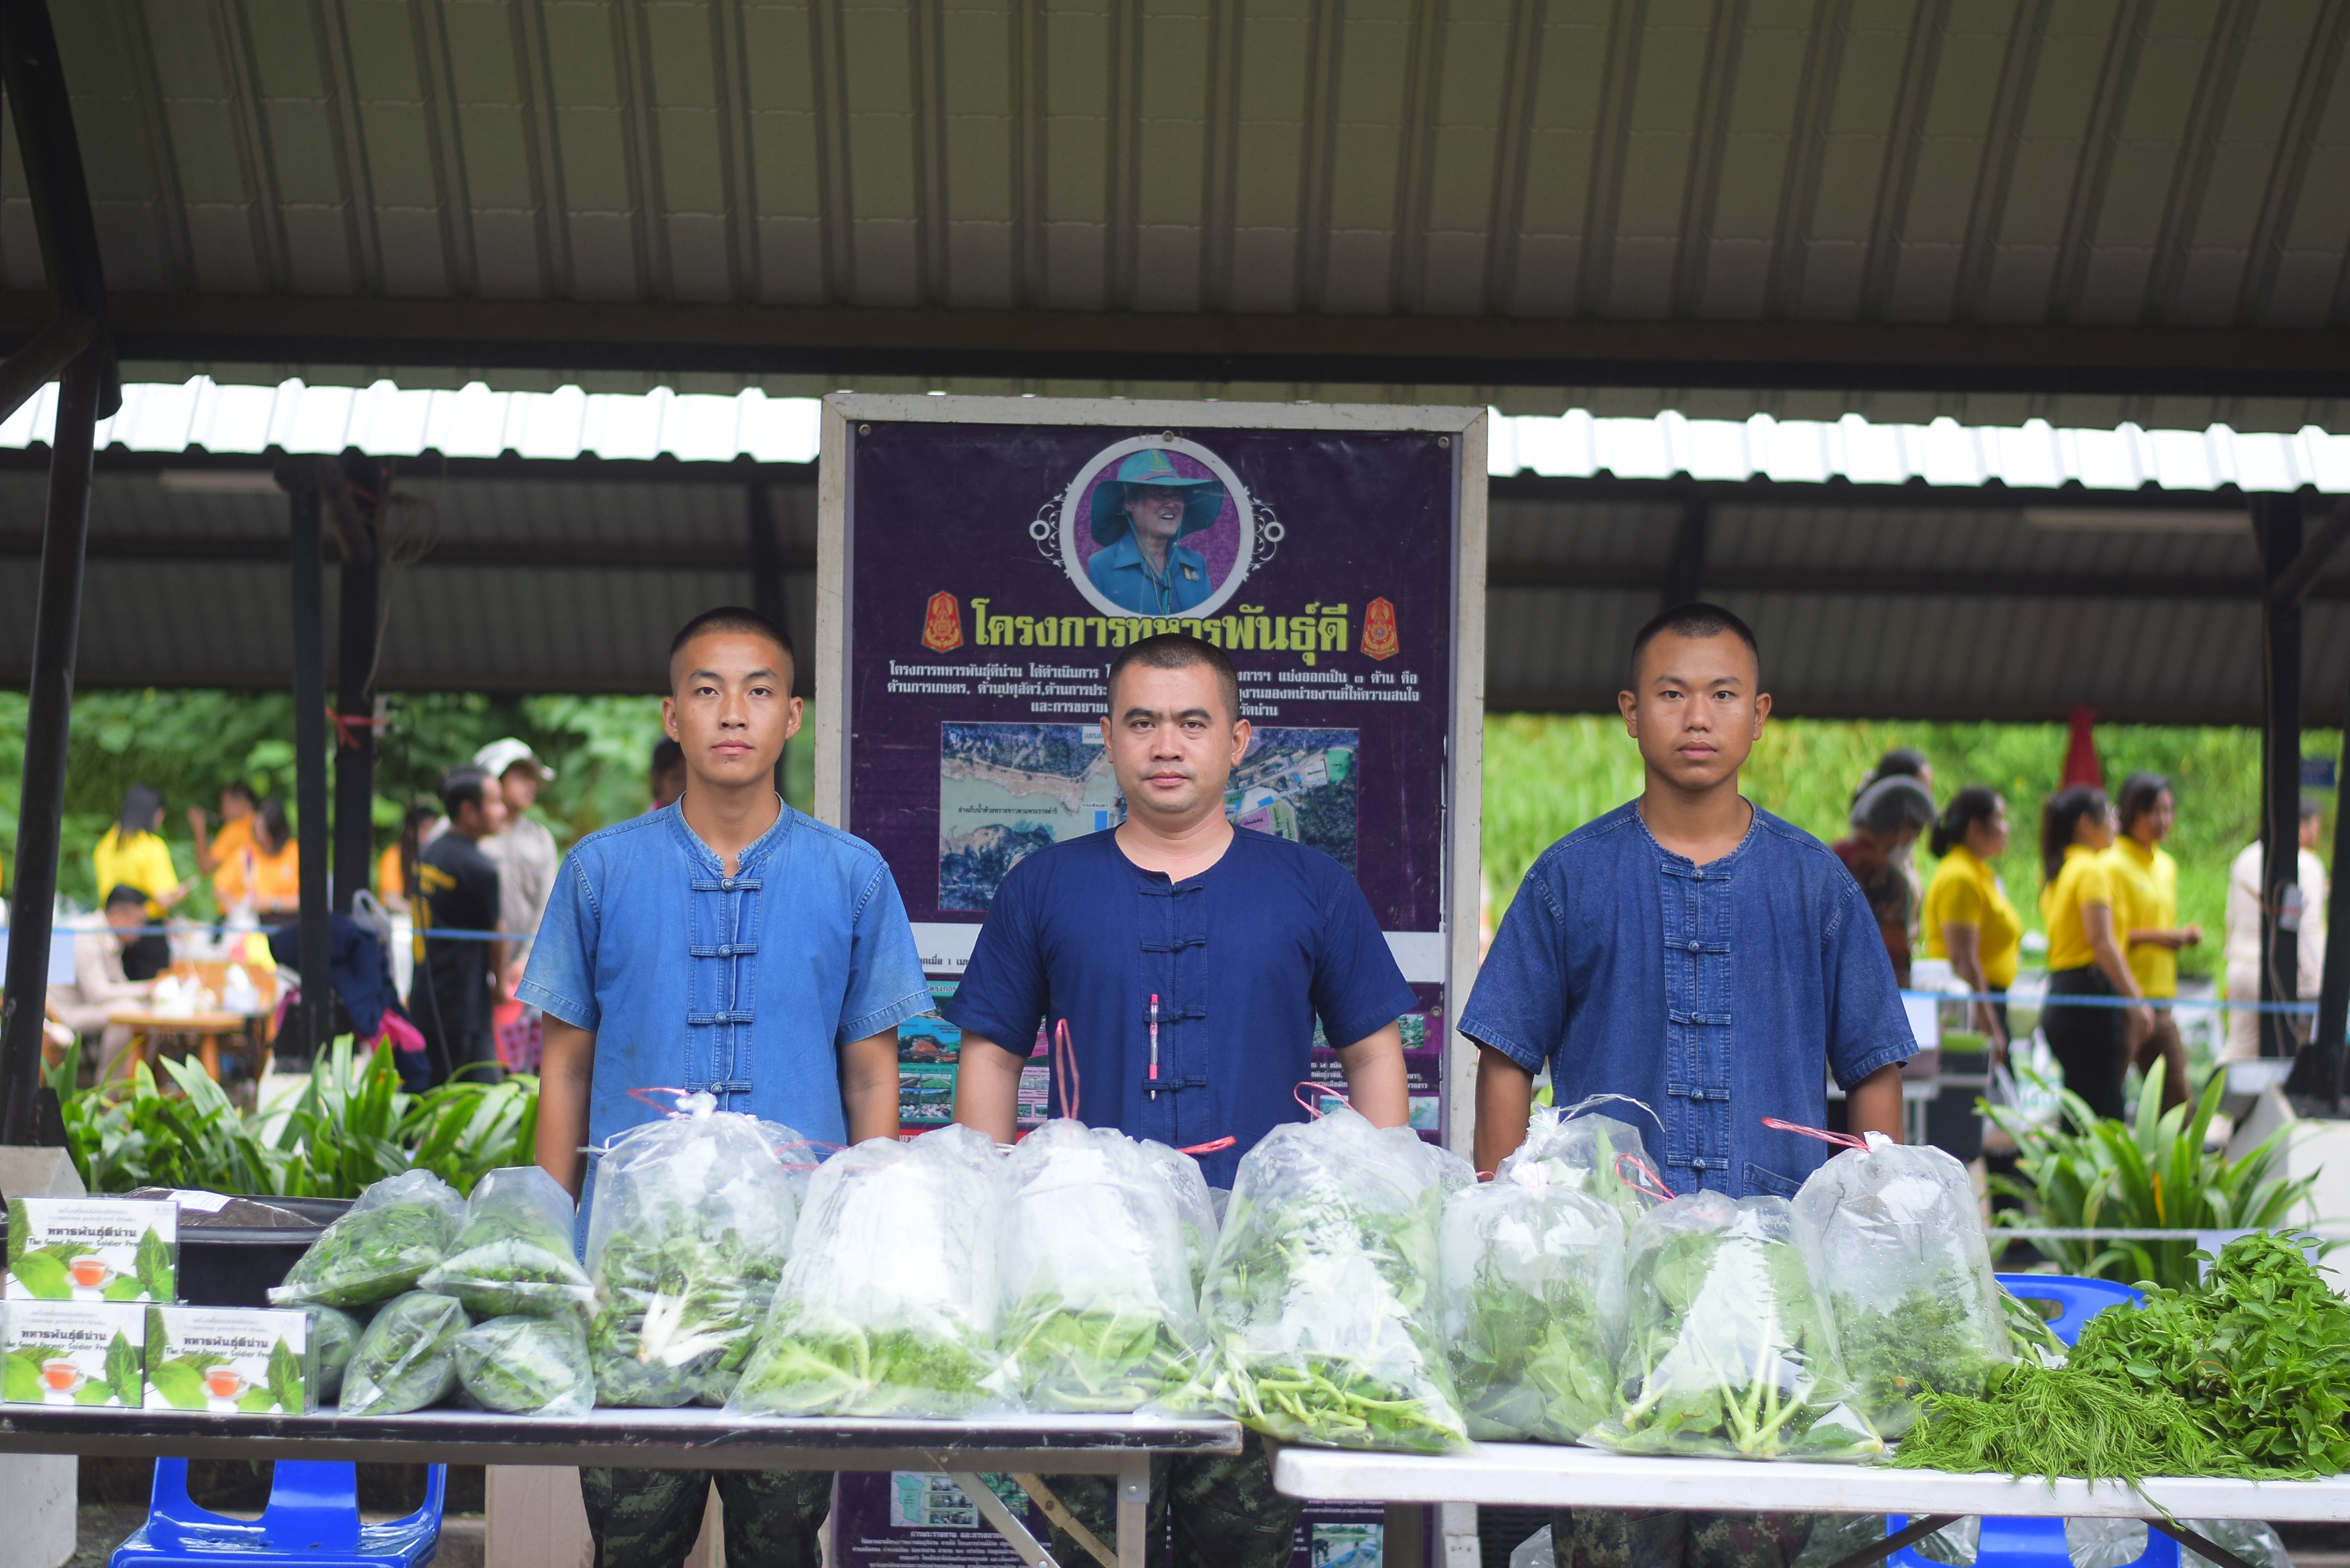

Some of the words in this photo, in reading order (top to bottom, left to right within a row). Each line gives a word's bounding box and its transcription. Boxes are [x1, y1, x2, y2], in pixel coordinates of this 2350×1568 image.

[890, 660, 1023, 681] โครงการทหารพันธุ์ดีน่าน
[1029, 662, 1099, 678] ได้ดำเนินการ
[1278, 668, 1347, 683] แบ่งออกเป็น
[1370, 670, 1394, 684] ด้าน
[1401, 671, 1418, 684] คือ
[1239, 684, 1420, 702] งานของหน่วยงานที่ให้ความสนใจ
